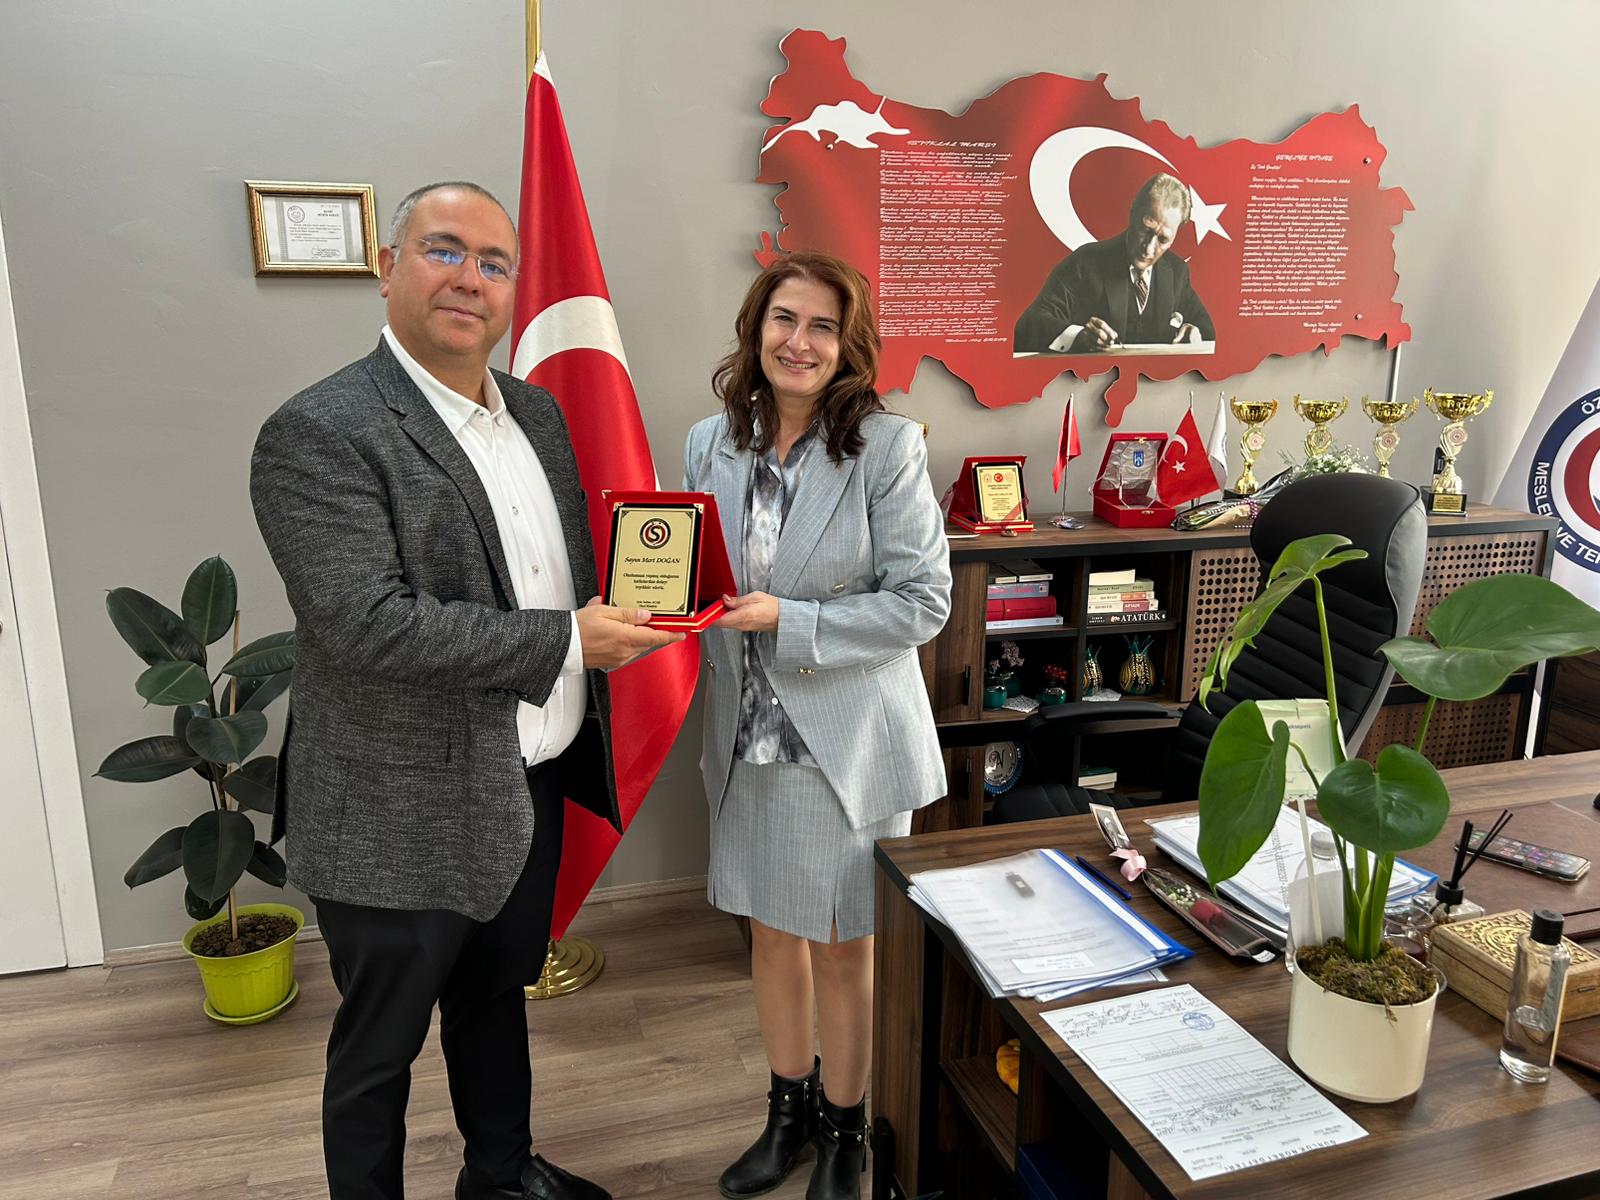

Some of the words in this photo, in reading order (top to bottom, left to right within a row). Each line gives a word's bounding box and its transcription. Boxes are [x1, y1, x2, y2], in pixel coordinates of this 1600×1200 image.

[1534, 462, 1554, 517] MESLE
[1556, 526, 1577, 549] VE
[1121, 612, 1160, 623] ATATÜRK
